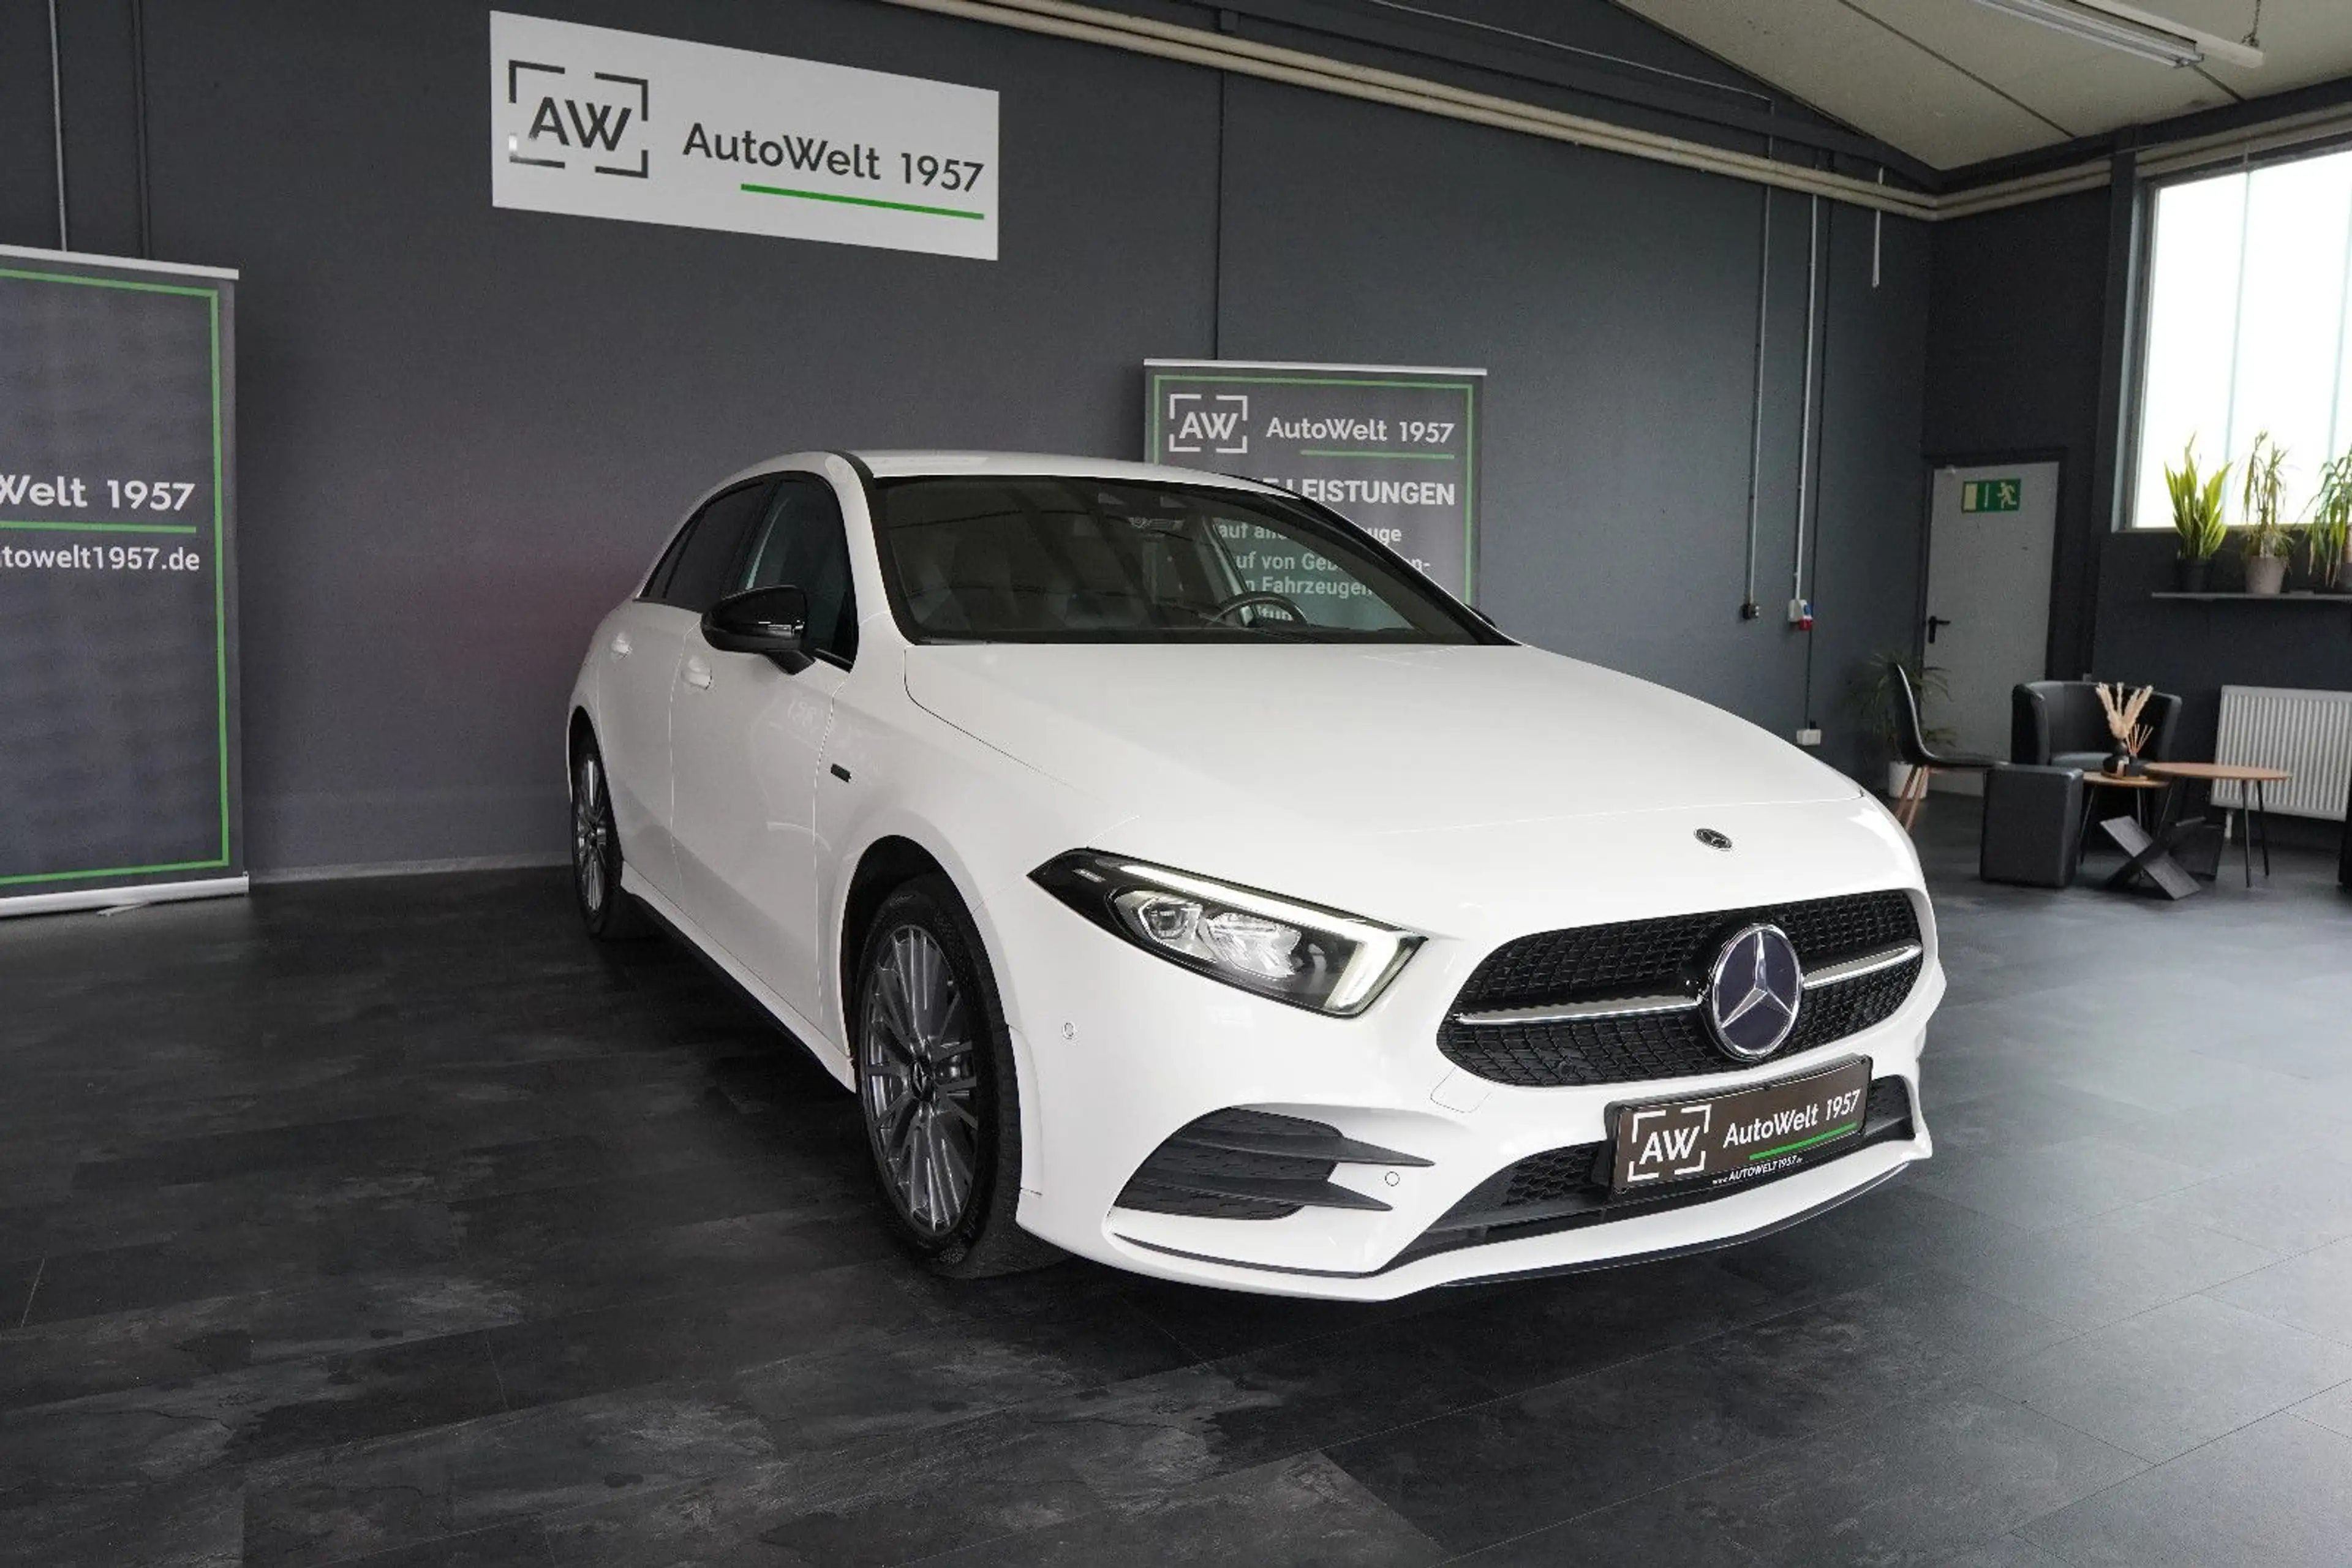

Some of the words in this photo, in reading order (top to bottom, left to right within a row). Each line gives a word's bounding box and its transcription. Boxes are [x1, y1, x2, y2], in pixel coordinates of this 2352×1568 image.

[528, 96, 631, 152] AW
[682, 123, 881, 180] AutoWelt
[901, 152, 984, 192] 1957
[1179, 412, 1238, 440] AW
[1265, 418, 1387, 442] AutoWelt
[1399, 422, 1455, 443] 1957
[107, 480, 196, 511] 1957
[0, 545, 200, 571] towelt1957.de
[1262, 556, 1295, 570] von
[1723, 1107, 1819, 1148] AutoWelt
[1825, 1089, 1861, 1121] 1957
[1639, 1126, 1701, 1165] AW
